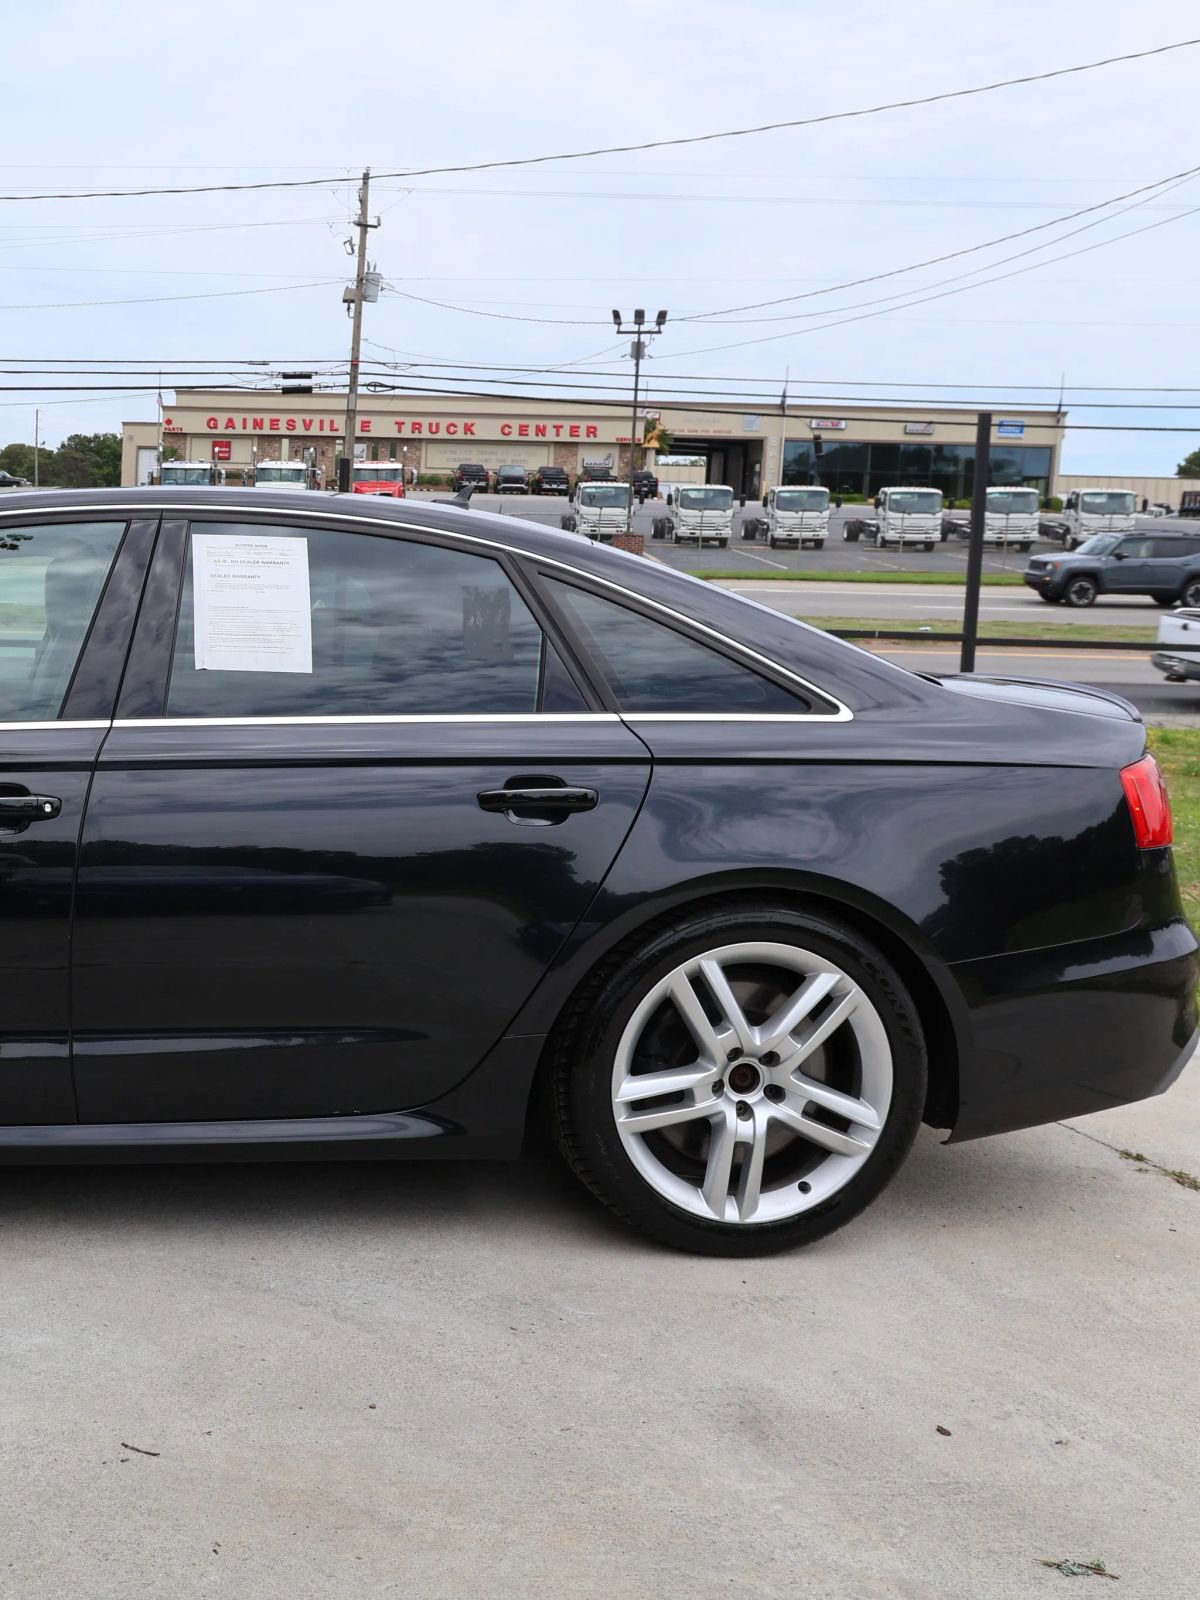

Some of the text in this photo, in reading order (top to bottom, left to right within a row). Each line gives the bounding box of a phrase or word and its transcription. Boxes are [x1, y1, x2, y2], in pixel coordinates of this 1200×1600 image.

[206, 416, 598, 437] GAINESVILE TRUCK CENTER
